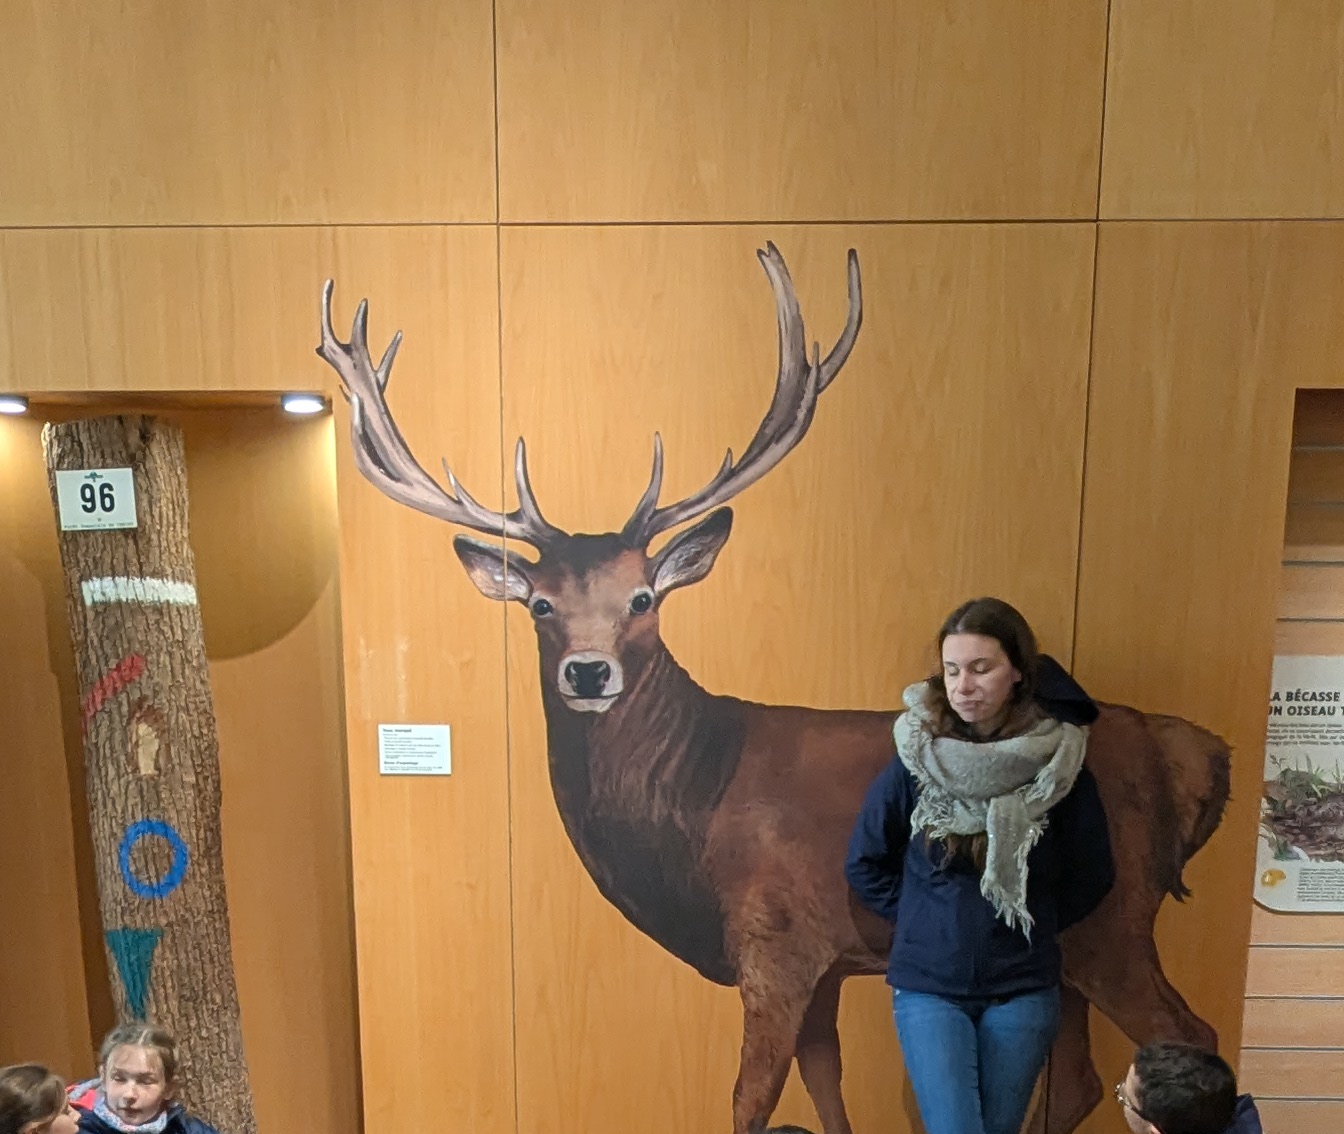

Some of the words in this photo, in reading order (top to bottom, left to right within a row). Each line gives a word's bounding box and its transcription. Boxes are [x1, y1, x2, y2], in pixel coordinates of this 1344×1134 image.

[80, 482, 115, 513] 96
[1285, 688, 1340, 702] BÉCASSE
[1287, 706, 1336, 716] OISEAU
